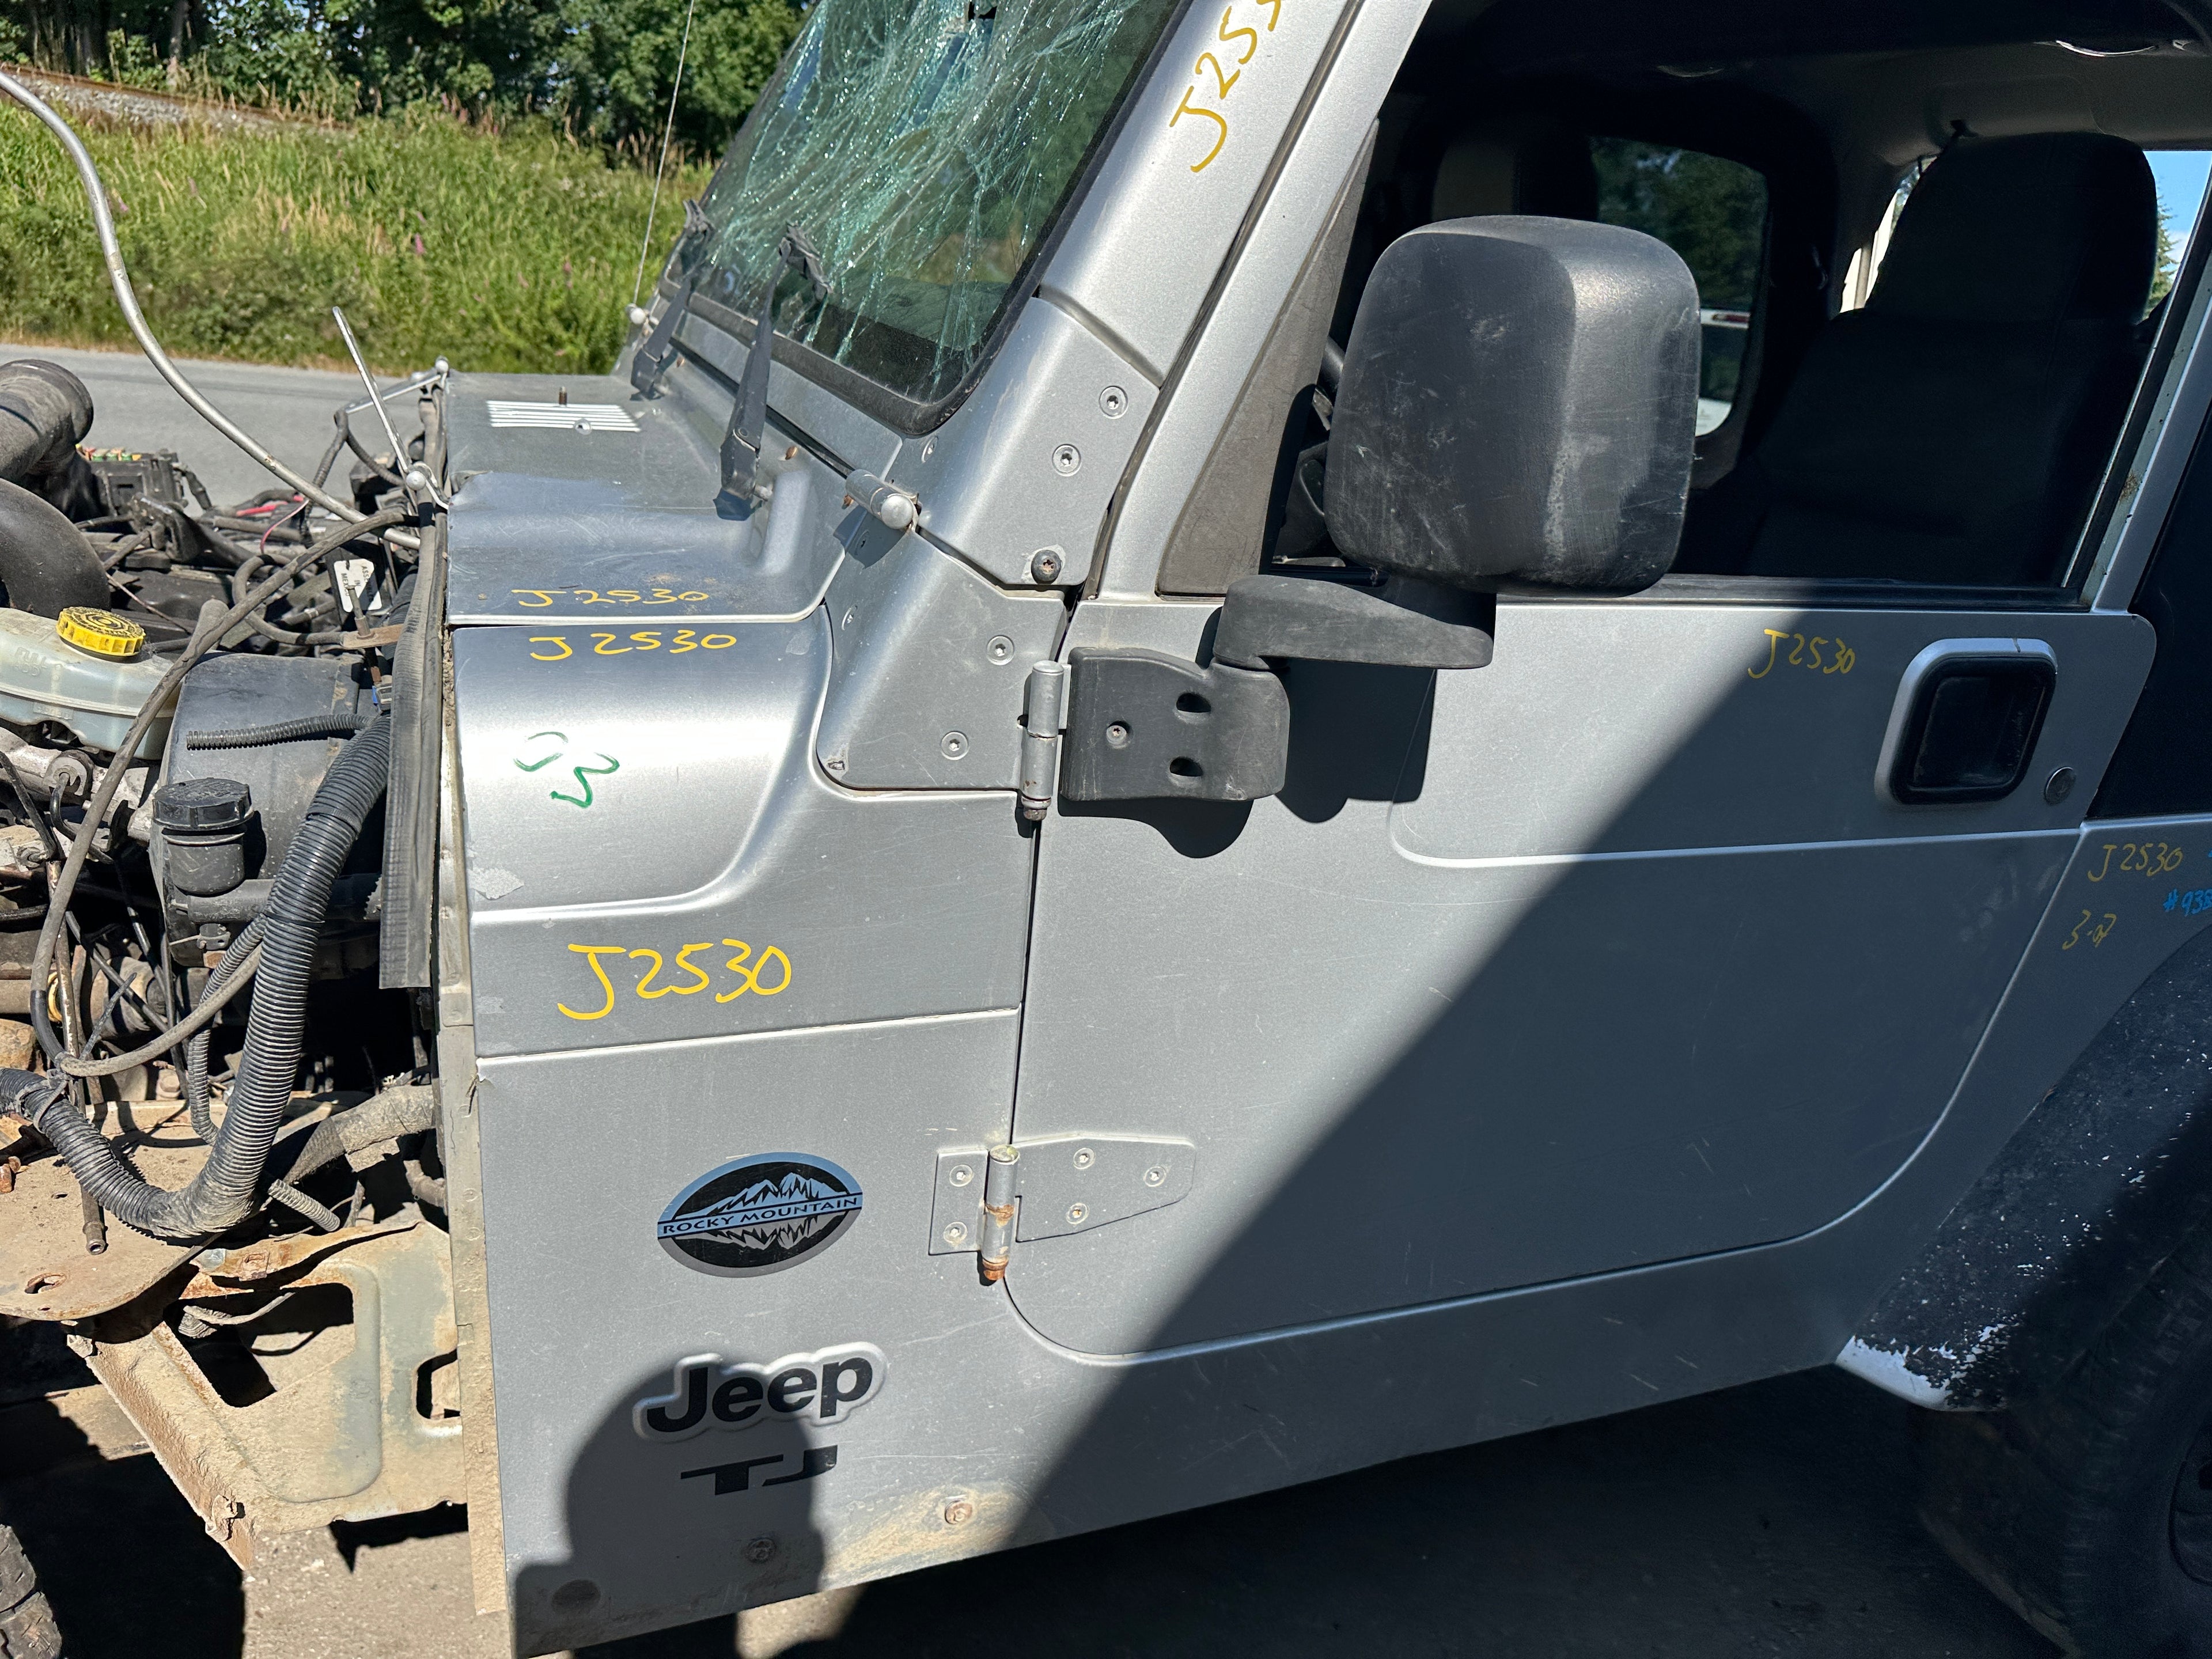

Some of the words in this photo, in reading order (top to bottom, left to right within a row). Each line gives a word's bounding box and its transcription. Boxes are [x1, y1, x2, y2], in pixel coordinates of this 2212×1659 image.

[511, 589, 709, 607] J2530
[1748, 628, 1855, 679] J2530
[2087, 843, 2183, 882] J2530
[557, 938, 792, 1020] J2530
[663, 1216, 735, 1234] ROCKY
[740, 1197, 857, 1222] MOUNTAIN
[647, 1357, 873, 1433] Jeep
[680, 1445, 838, 1495] TJ
